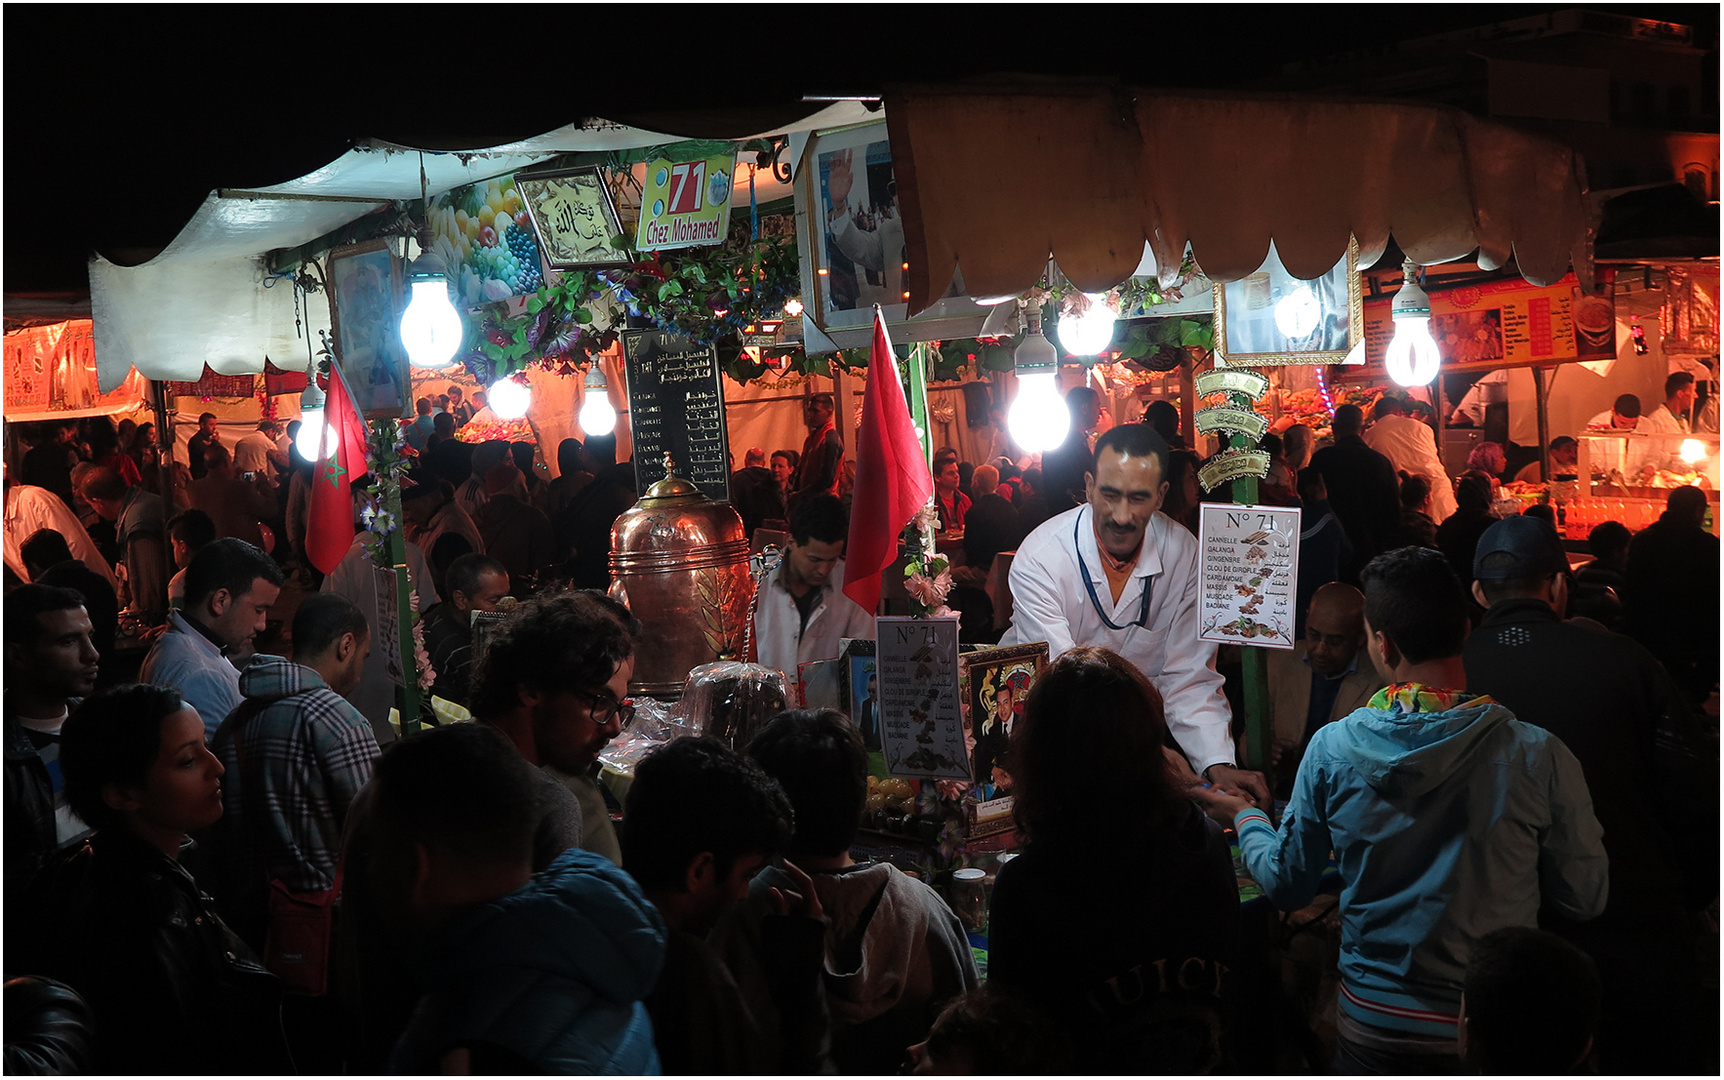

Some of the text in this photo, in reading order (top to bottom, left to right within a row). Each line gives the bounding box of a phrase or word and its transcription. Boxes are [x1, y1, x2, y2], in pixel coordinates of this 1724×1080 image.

[669, 162, 706, 213] 71
[646, 213, 721, 245] Chez Mohamed
[1256, 514, 1274, 531] 71
[1207, 536, 1238, 545] CANNELLE
[1207, 546, 1235, 554] GALANGA
[1232, 566, 1257, 574] GIROFLE
[1206, 574, 1243, 583] CARDAMOME
[1206, 593, 1234, 601] MUSCADE
[1206, 602, 1230, 610] BADIANE
[921, 626, 936, 644] 71
[883, 655, 907, 663] CANNELLE
[884, 688, 926, 697] CLOU DE GIROFLE
[885, 699, 915, 707] CARDAMOME
[886, 721, 910, 729] MUSCADE
[888, 732, 909, 740] BADIANE
